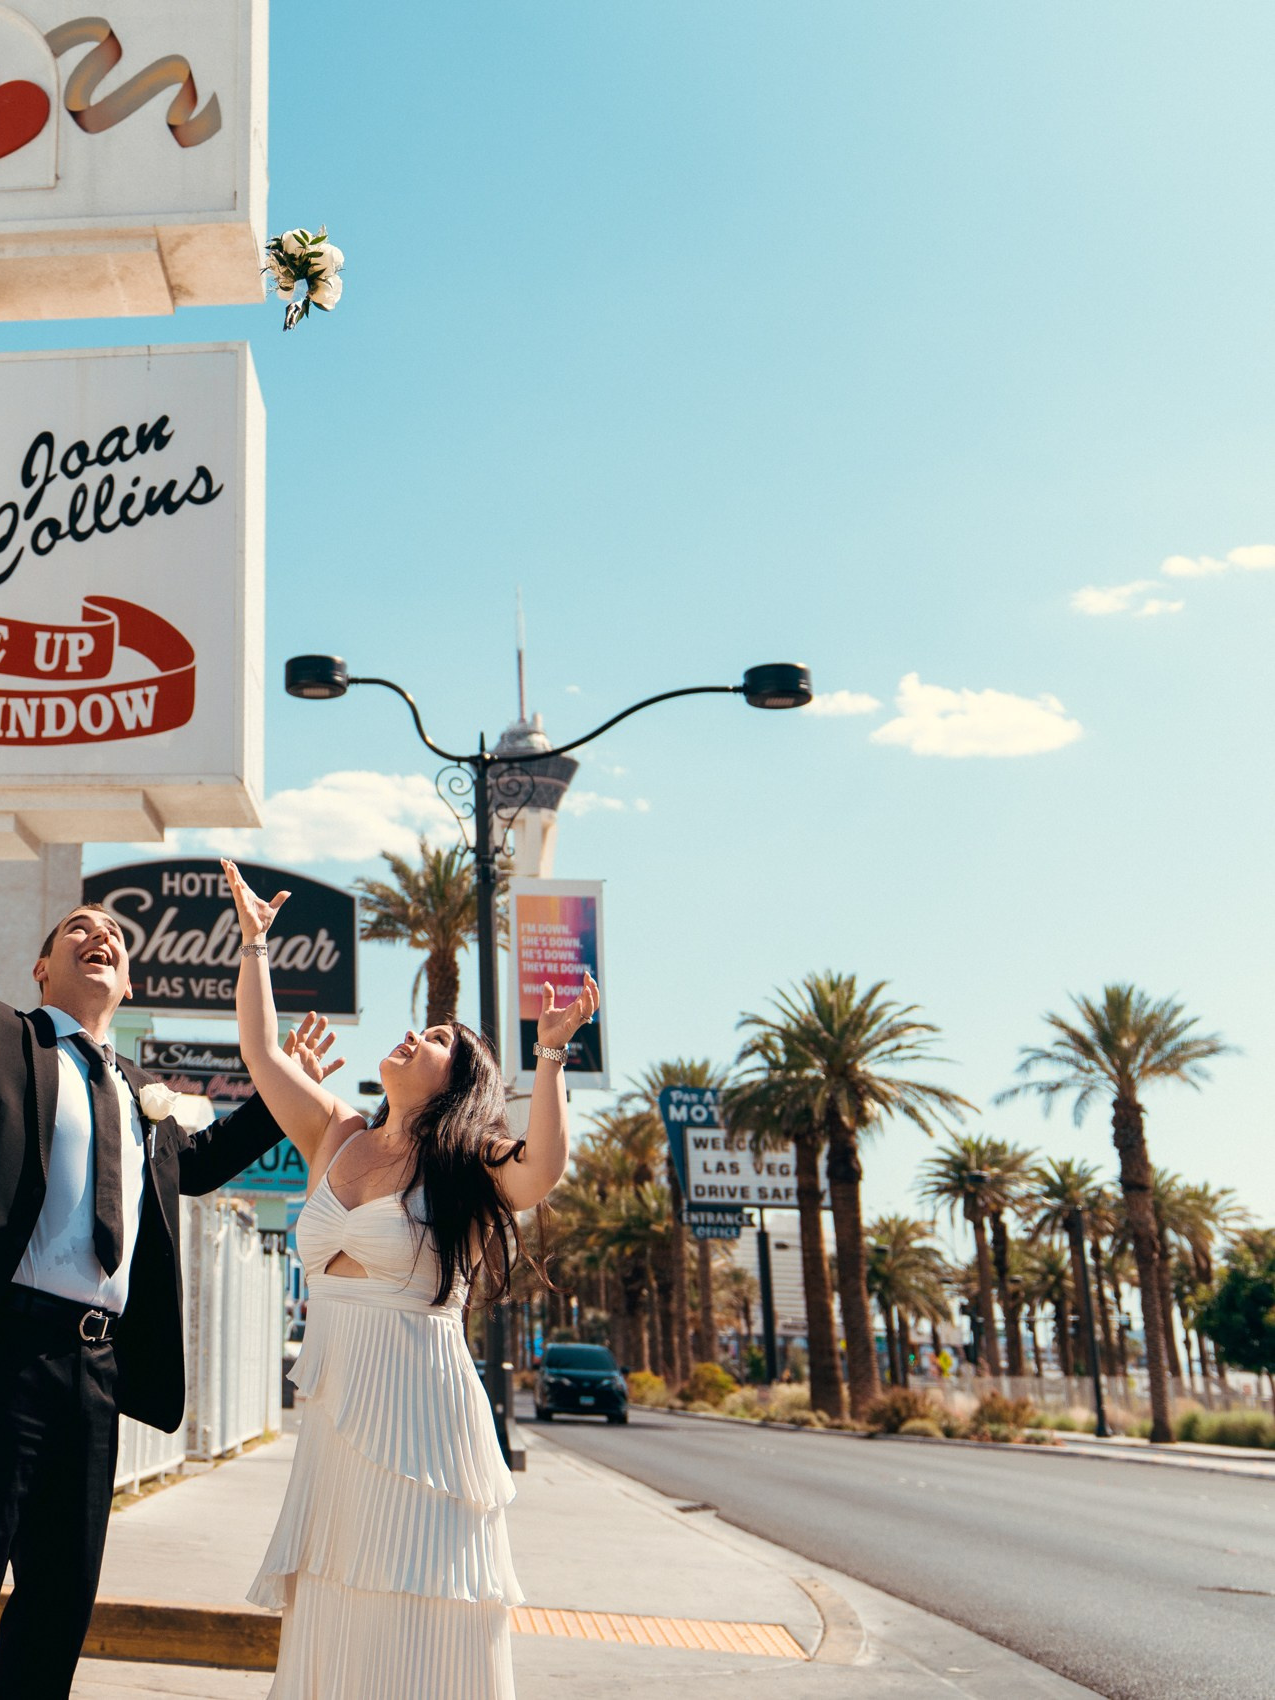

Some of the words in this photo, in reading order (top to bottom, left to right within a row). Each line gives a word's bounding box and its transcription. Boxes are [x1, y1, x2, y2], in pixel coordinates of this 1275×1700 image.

[21, 414, 175, 521] Joan
[33, 631, 96, 673] UP
[161, 872, 233, 898] HOTE
[549, 937, 583, 949] DOWN.
[146, 975, 185, 999] LAS
[189, 978, 237, 1001] VEG
[669, 1104, 720, 1122] MOT
[702, 1161, 740, 1175] LAS
[752, 1162, 791, 1177] VEG
[694, 1184, 751, 1199] DRIVE
[757, 1186, 795, 1200] SAF
[682, 1210, 751, 1227] ENTRANCE
